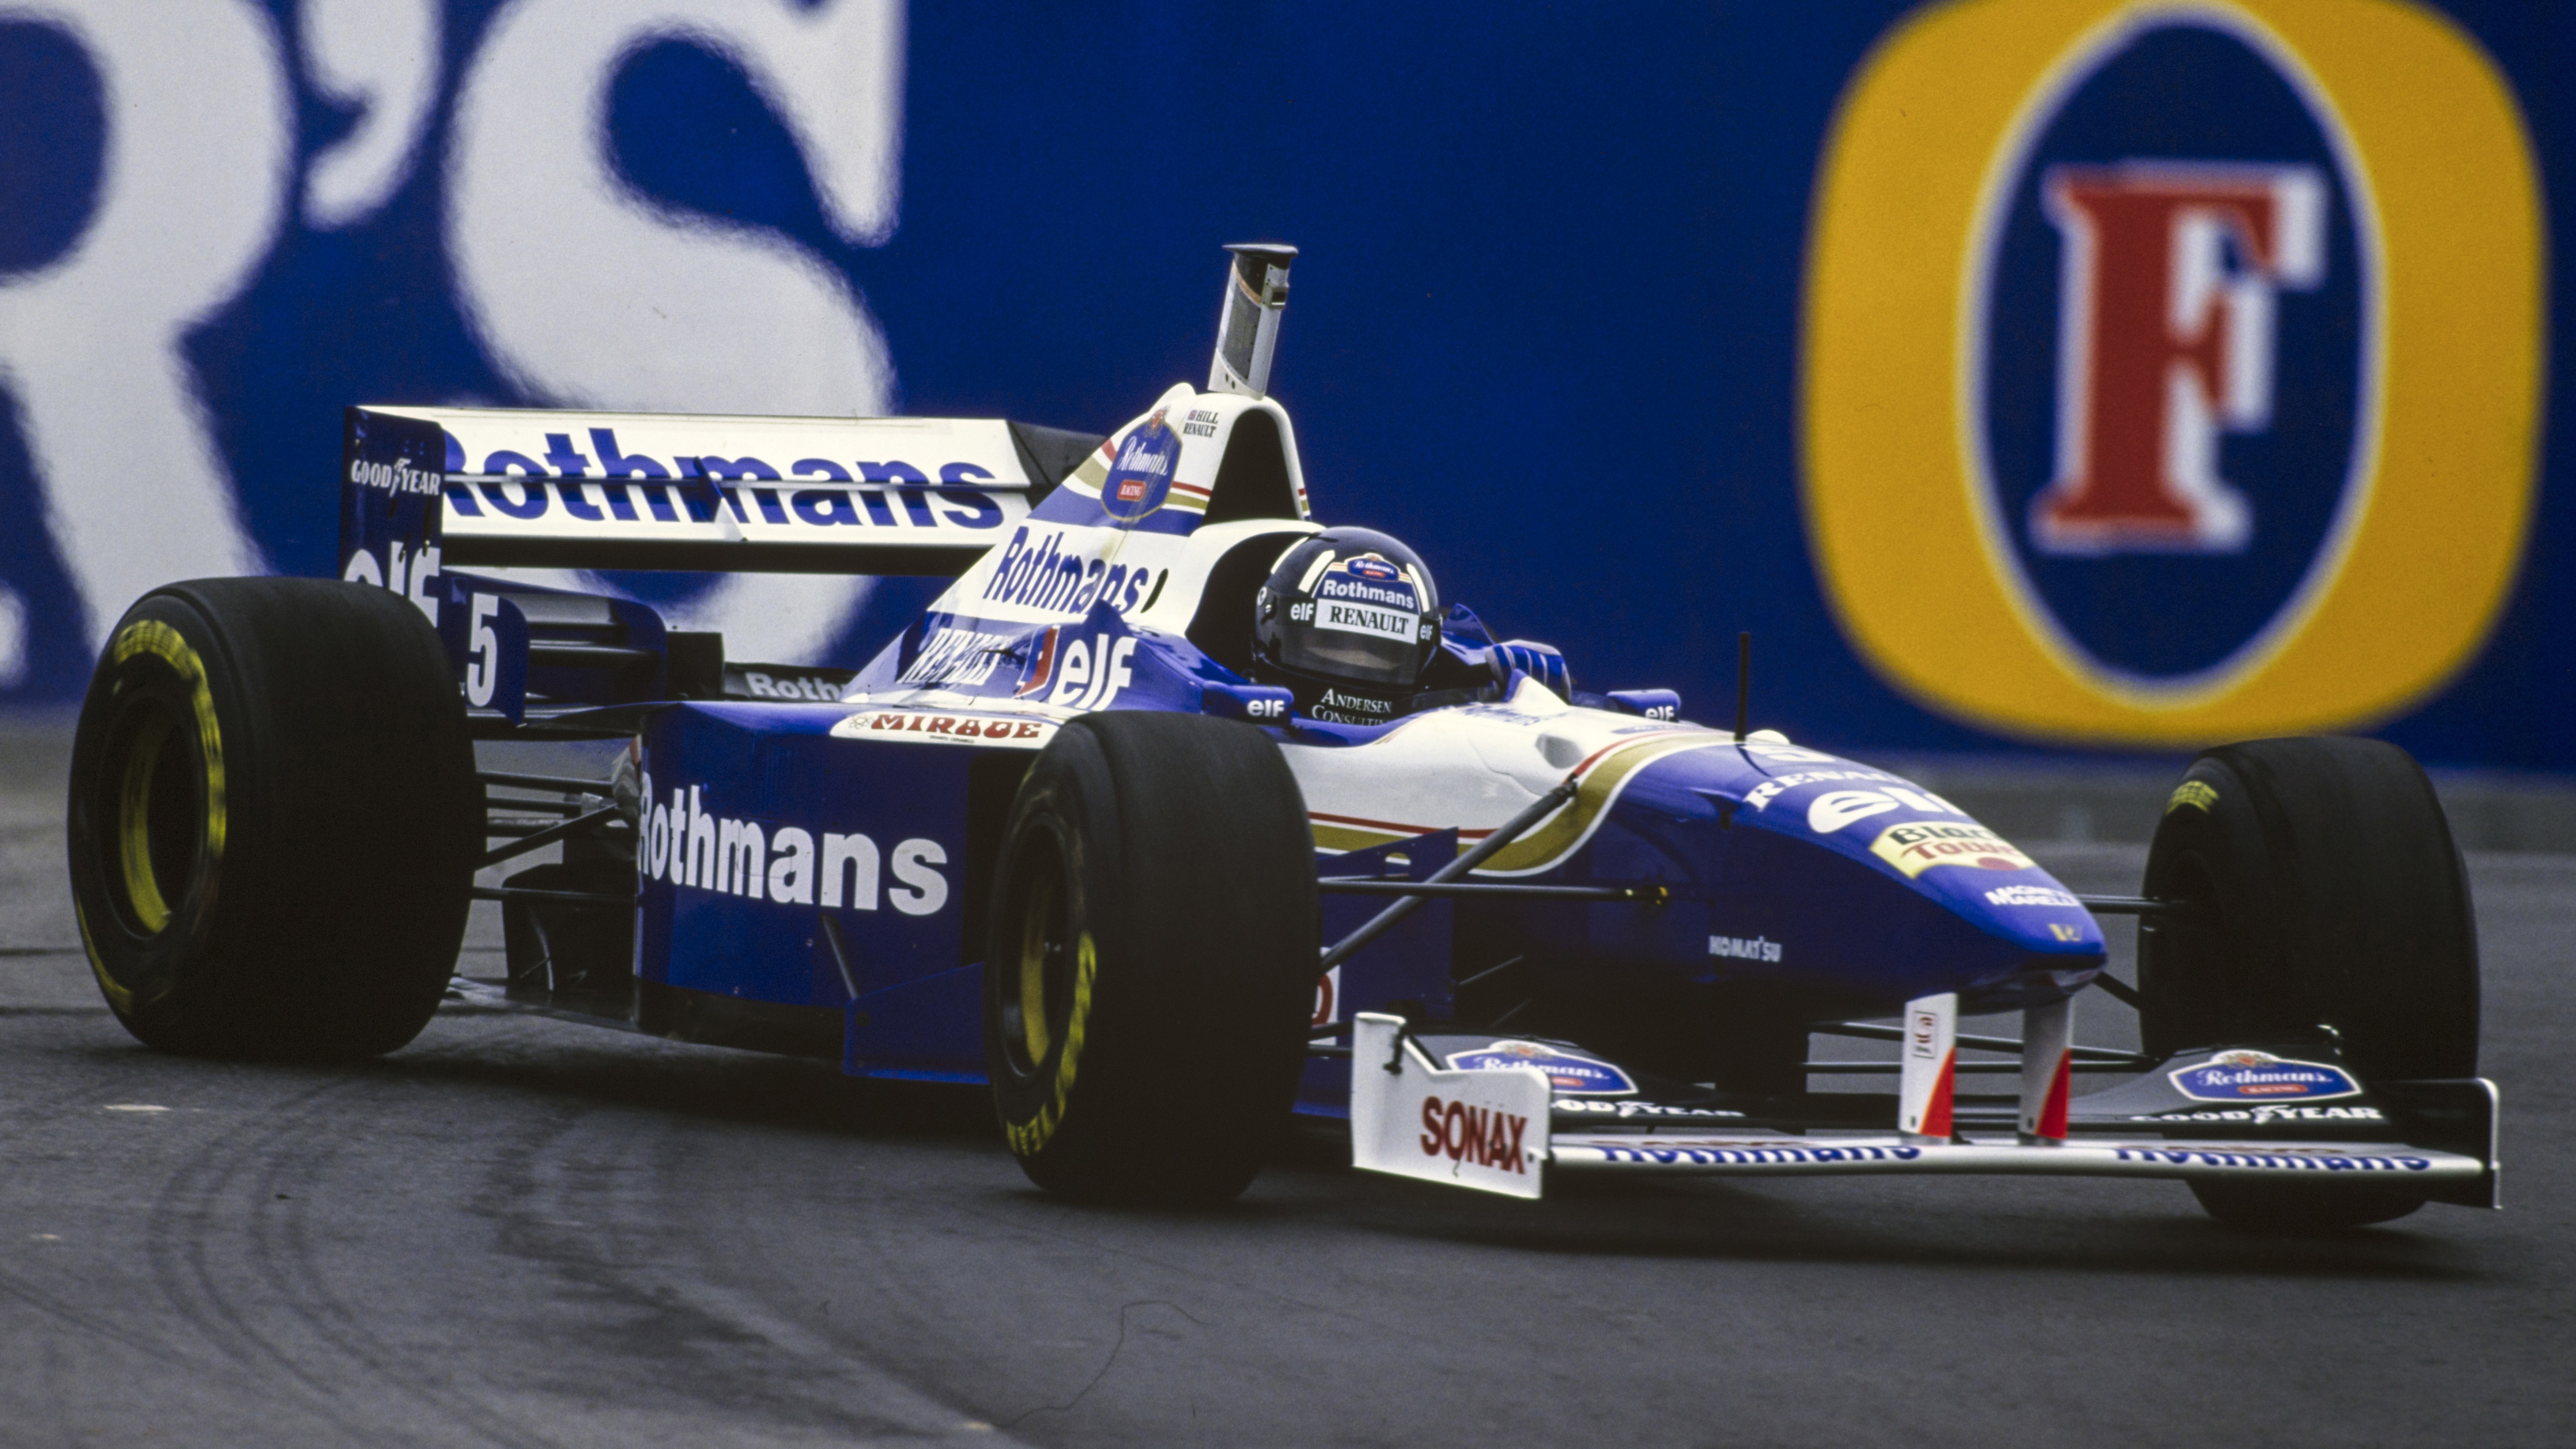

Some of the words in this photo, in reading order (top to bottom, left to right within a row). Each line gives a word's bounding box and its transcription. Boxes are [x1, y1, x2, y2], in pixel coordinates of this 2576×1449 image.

[1183, 422, 1216, 438] RENAULT
[1196, 410, 1218, 424] HILL
[1116, 436, 1168, 476] Rothmans
[982, 525, 1149, 615] Rothmans
[1323, 579, 1414, 609] Rothmans
[1290, 602, 1315, 622] elf
[1329, 605, 1409, 634] RENAULT
[1420, 623, 1434, 640] elf
[466, 592, 499, 708] 5
[1048, 633, 1139, 711] elf
[745, 672, 849, 701] Roth
[1247, 699, 1285, 717] elf
[1320, 688, 1392, 713] ANDERSEN
[1645, 705, 1674, 722] elf
[870, 713, 1043, 740] MIRAGE
[637, 771, 949, 915] Rothmans
[1888, 826, 2001, 845] Blac
[2196, 1069, 2333, 1087] Rothmans
[1551, 1099, 1745, 1118] ODYEAR
[1420, 1095, 1528, 1175] SONAX
